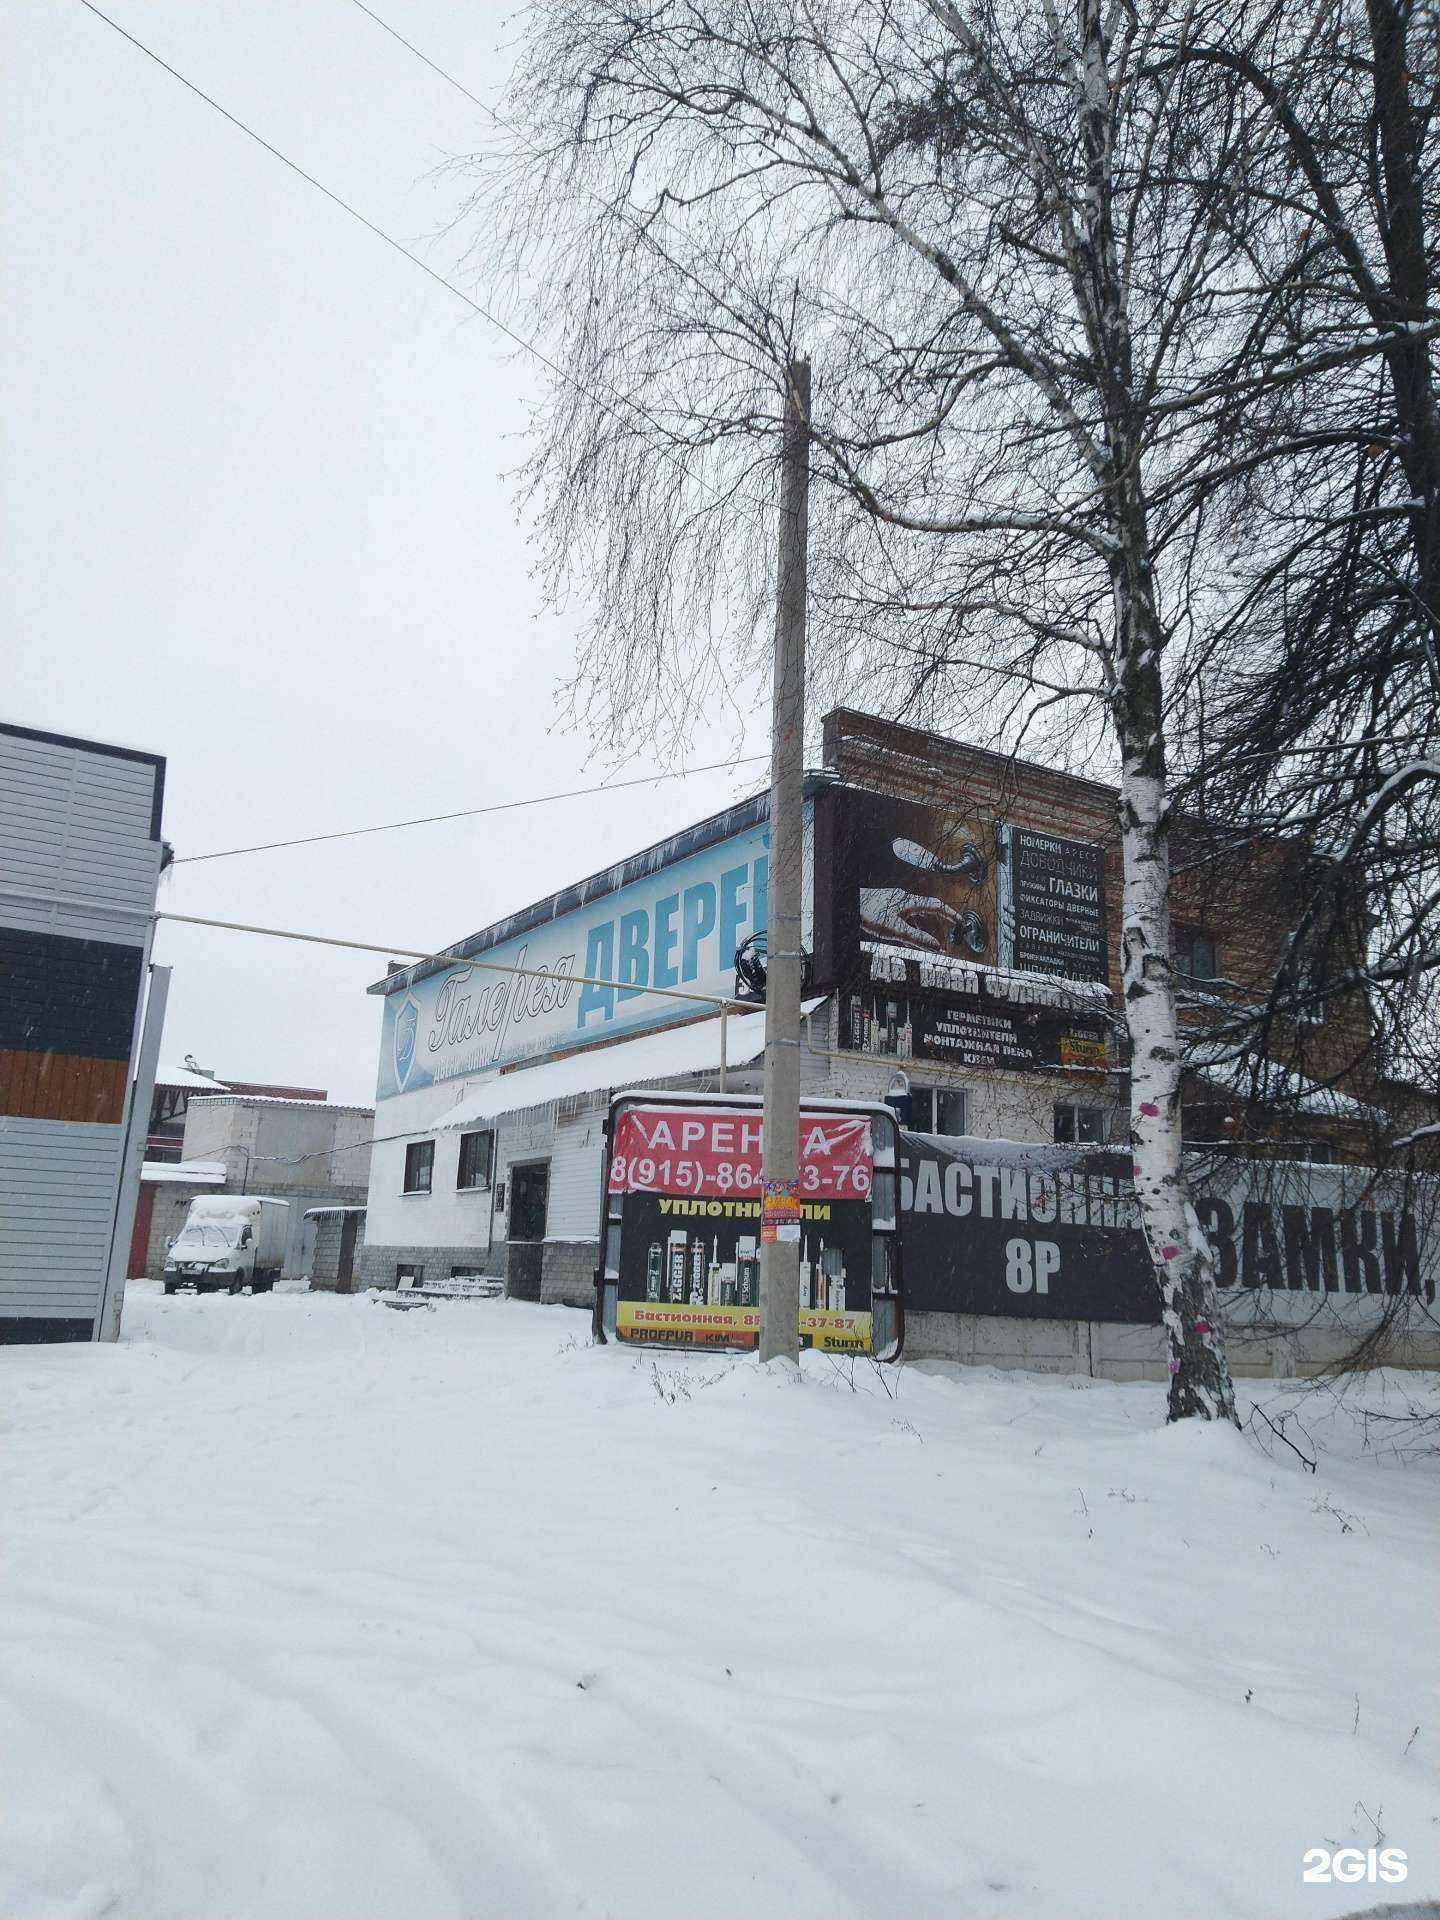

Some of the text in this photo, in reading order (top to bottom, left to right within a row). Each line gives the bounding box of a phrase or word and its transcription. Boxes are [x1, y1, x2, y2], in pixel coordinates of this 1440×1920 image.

[1020, 834, 1062, 854] НОМЕРКИ
[1049, 877, 1098, 902] ГЛАЗКИ
[1020, 893, 1099, 917] ФИКСАТОРЫ ДВЕРНЫЕ
[1020, 925, 1100, 953] ОГРАНИЧИТЕЛИ
[428, 943, 576, 1062] Галерея
[923, 1033, 1000, 1055] МОНТАЖНАЯ
[648, 1121, 831, 1158] АРЕНА
[1005, 1238, 1060, 1294] 8Р
